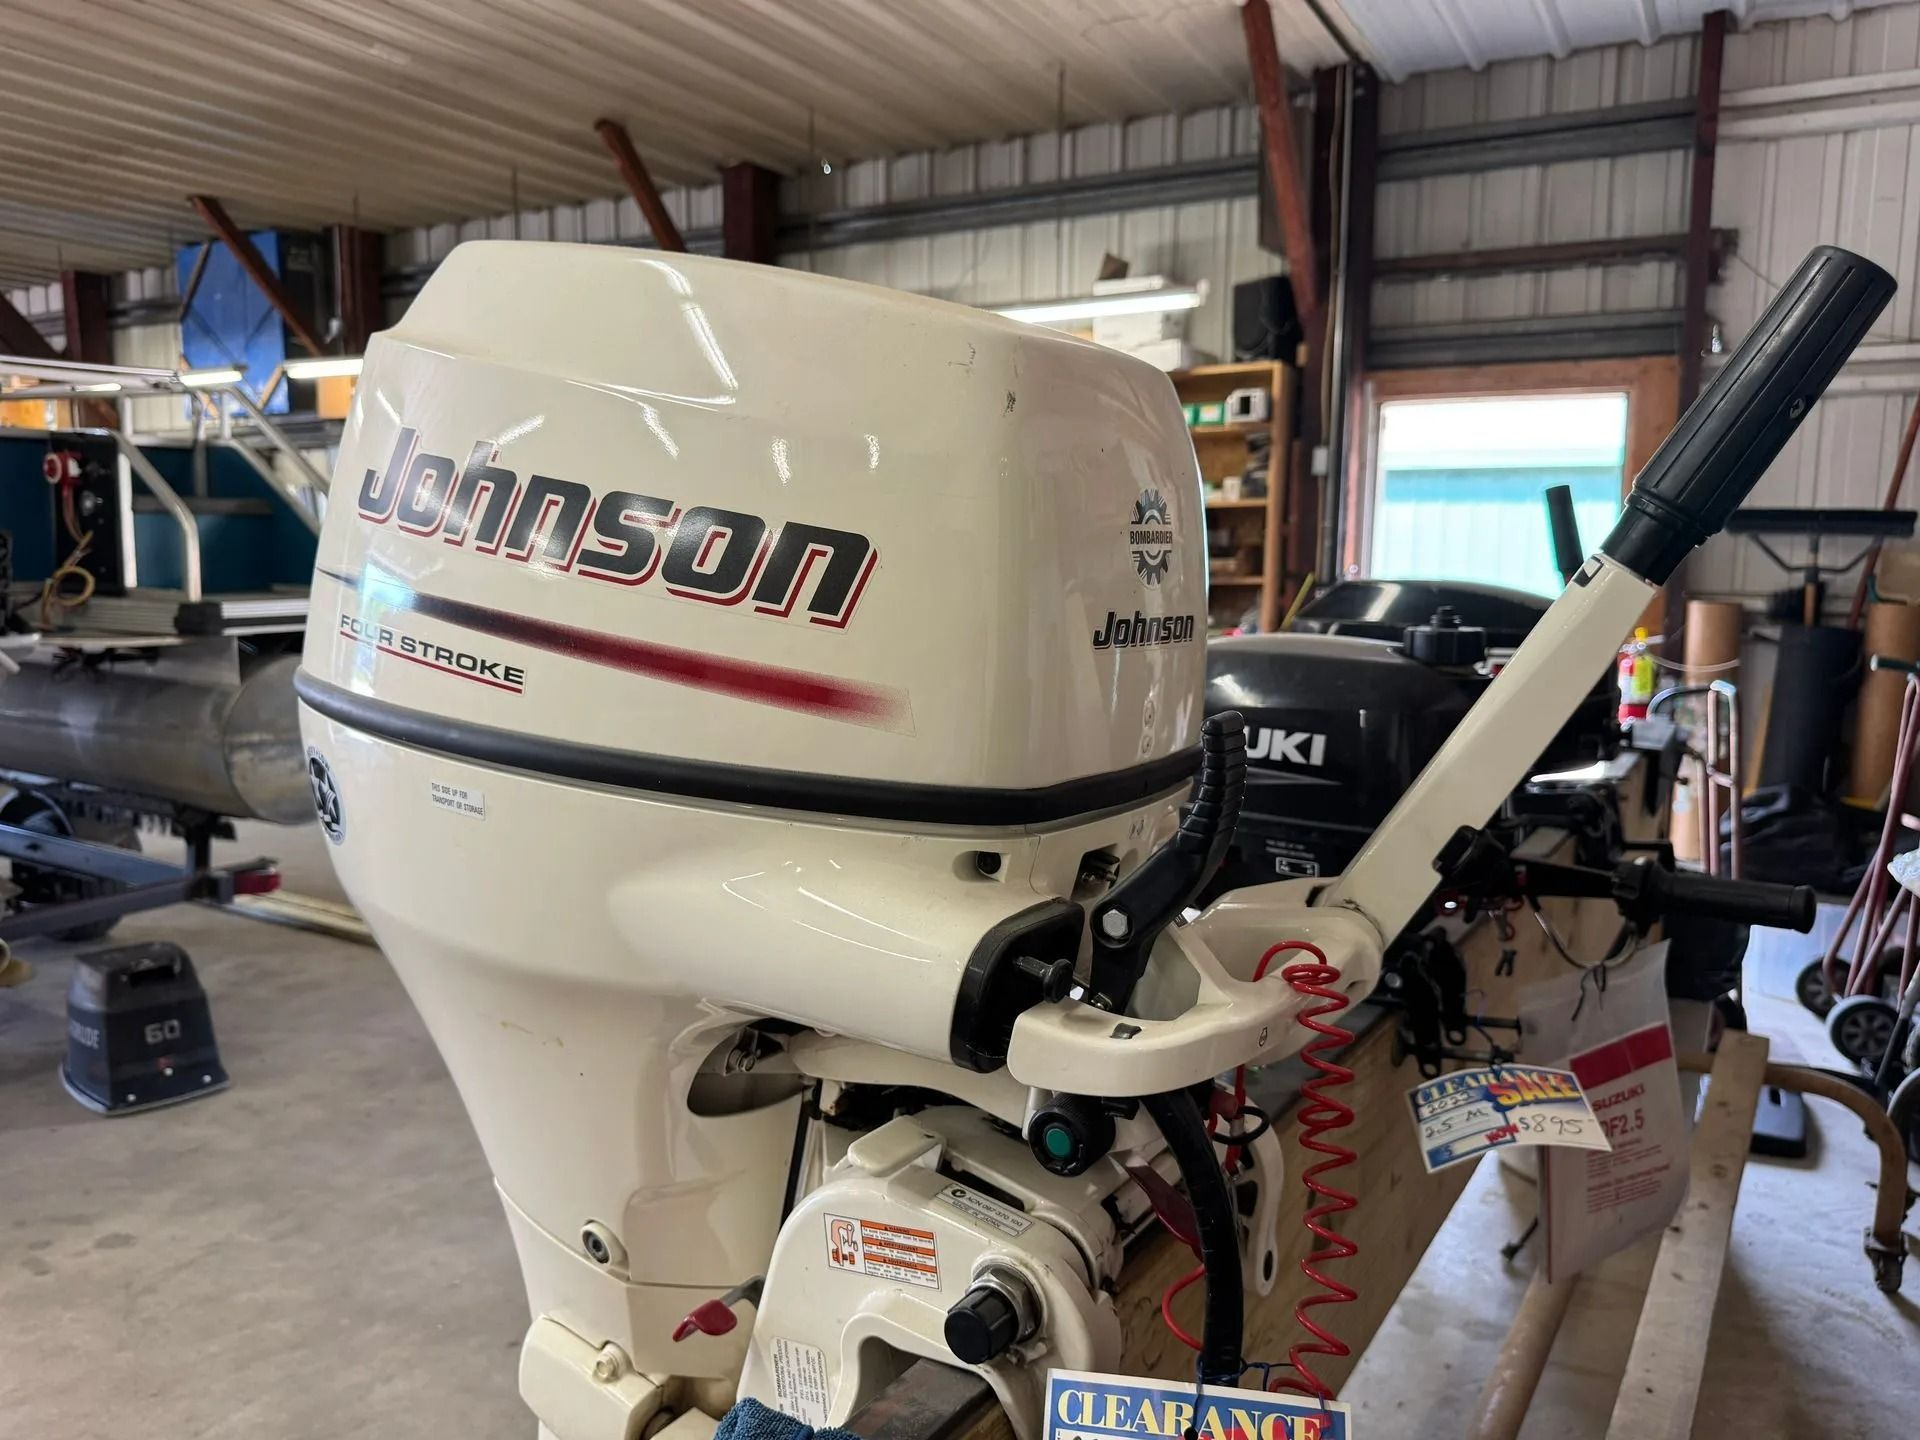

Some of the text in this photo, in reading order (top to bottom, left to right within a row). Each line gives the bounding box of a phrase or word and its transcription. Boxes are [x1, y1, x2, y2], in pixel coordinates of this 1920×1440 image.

[357, 427, 879, 630] Johnson
[1129, 530, 1173, 545] BOMBARDIER
[340, 614, 525, 686] FOUR STROKE
[1092, 610, 1195, 650] Johnson
[1245, 725, 1327, 767] UKI
[144, 1019, 180, 1045] 60
[1488, 1076, 1581, 1106] SALE
[1592, 1083, 1645, 1112] SUZUKI
[1057, 1389, 1322, 1440] CLEARANCE
